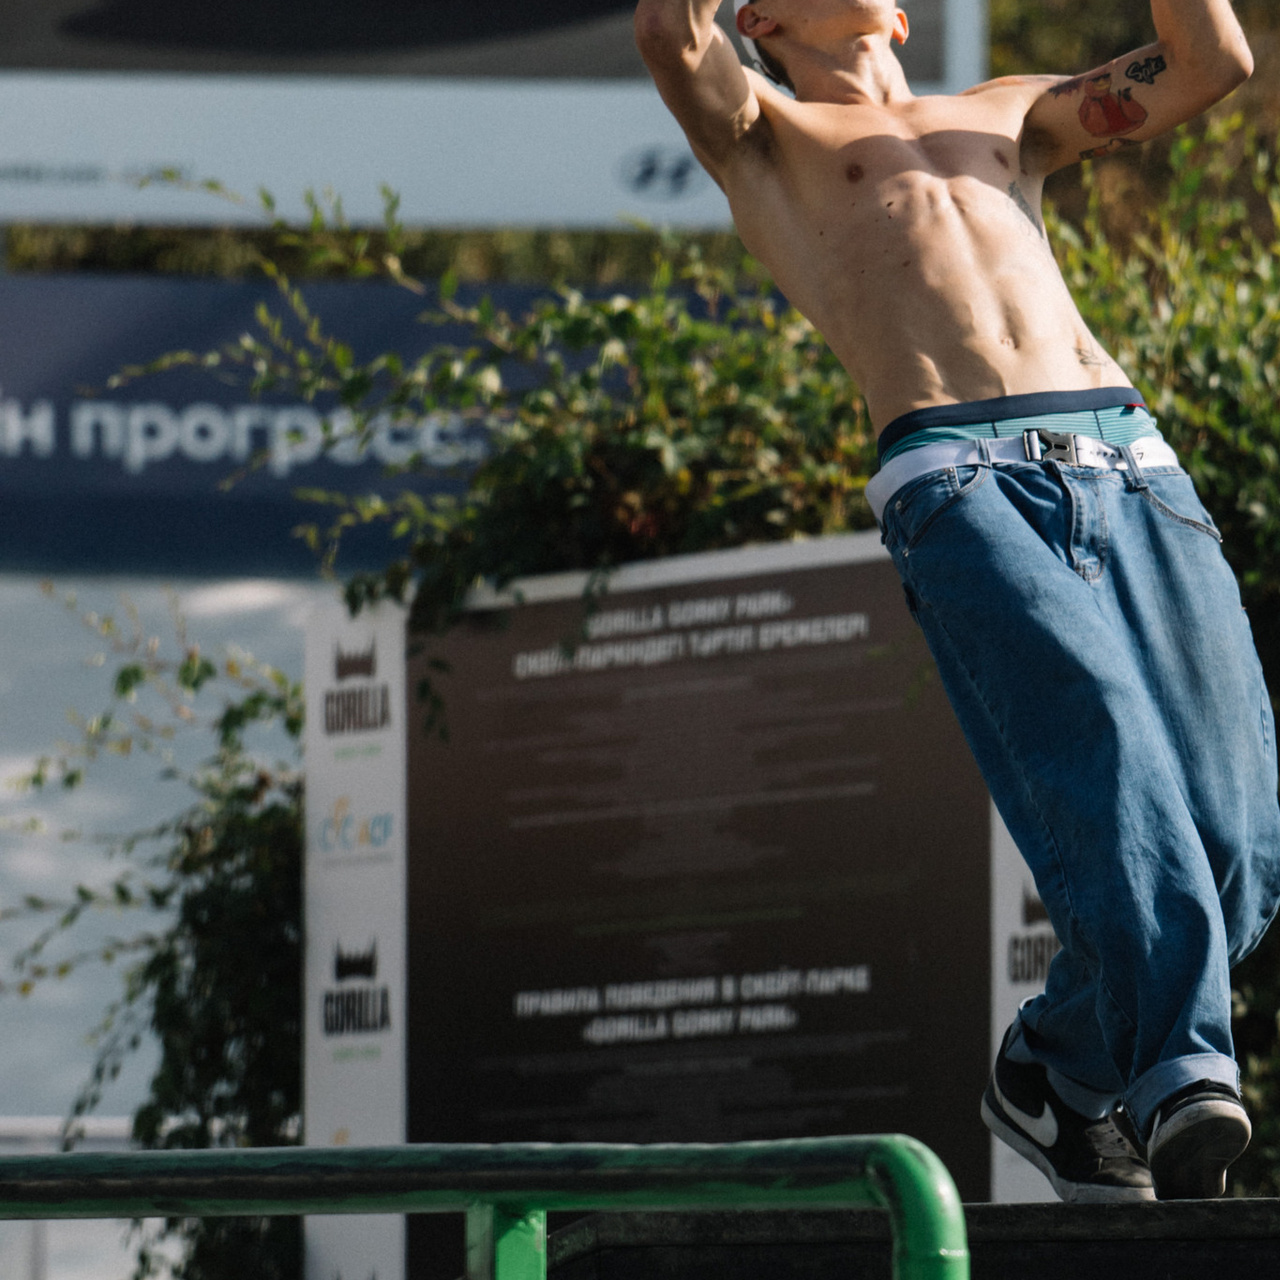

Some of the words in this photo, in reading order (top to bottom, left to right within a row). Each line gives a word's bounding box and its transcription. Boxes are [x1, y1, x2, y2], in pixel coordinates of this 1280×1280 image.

[0, 400, 55, 458] н
[324, 683, 391, 733] GORILLA
[1009, 934, 1060, 983] GORI
[325, 985, 391, 1035] GORILLA
[516, 986, 599, 1017] ПРАВИЛА
